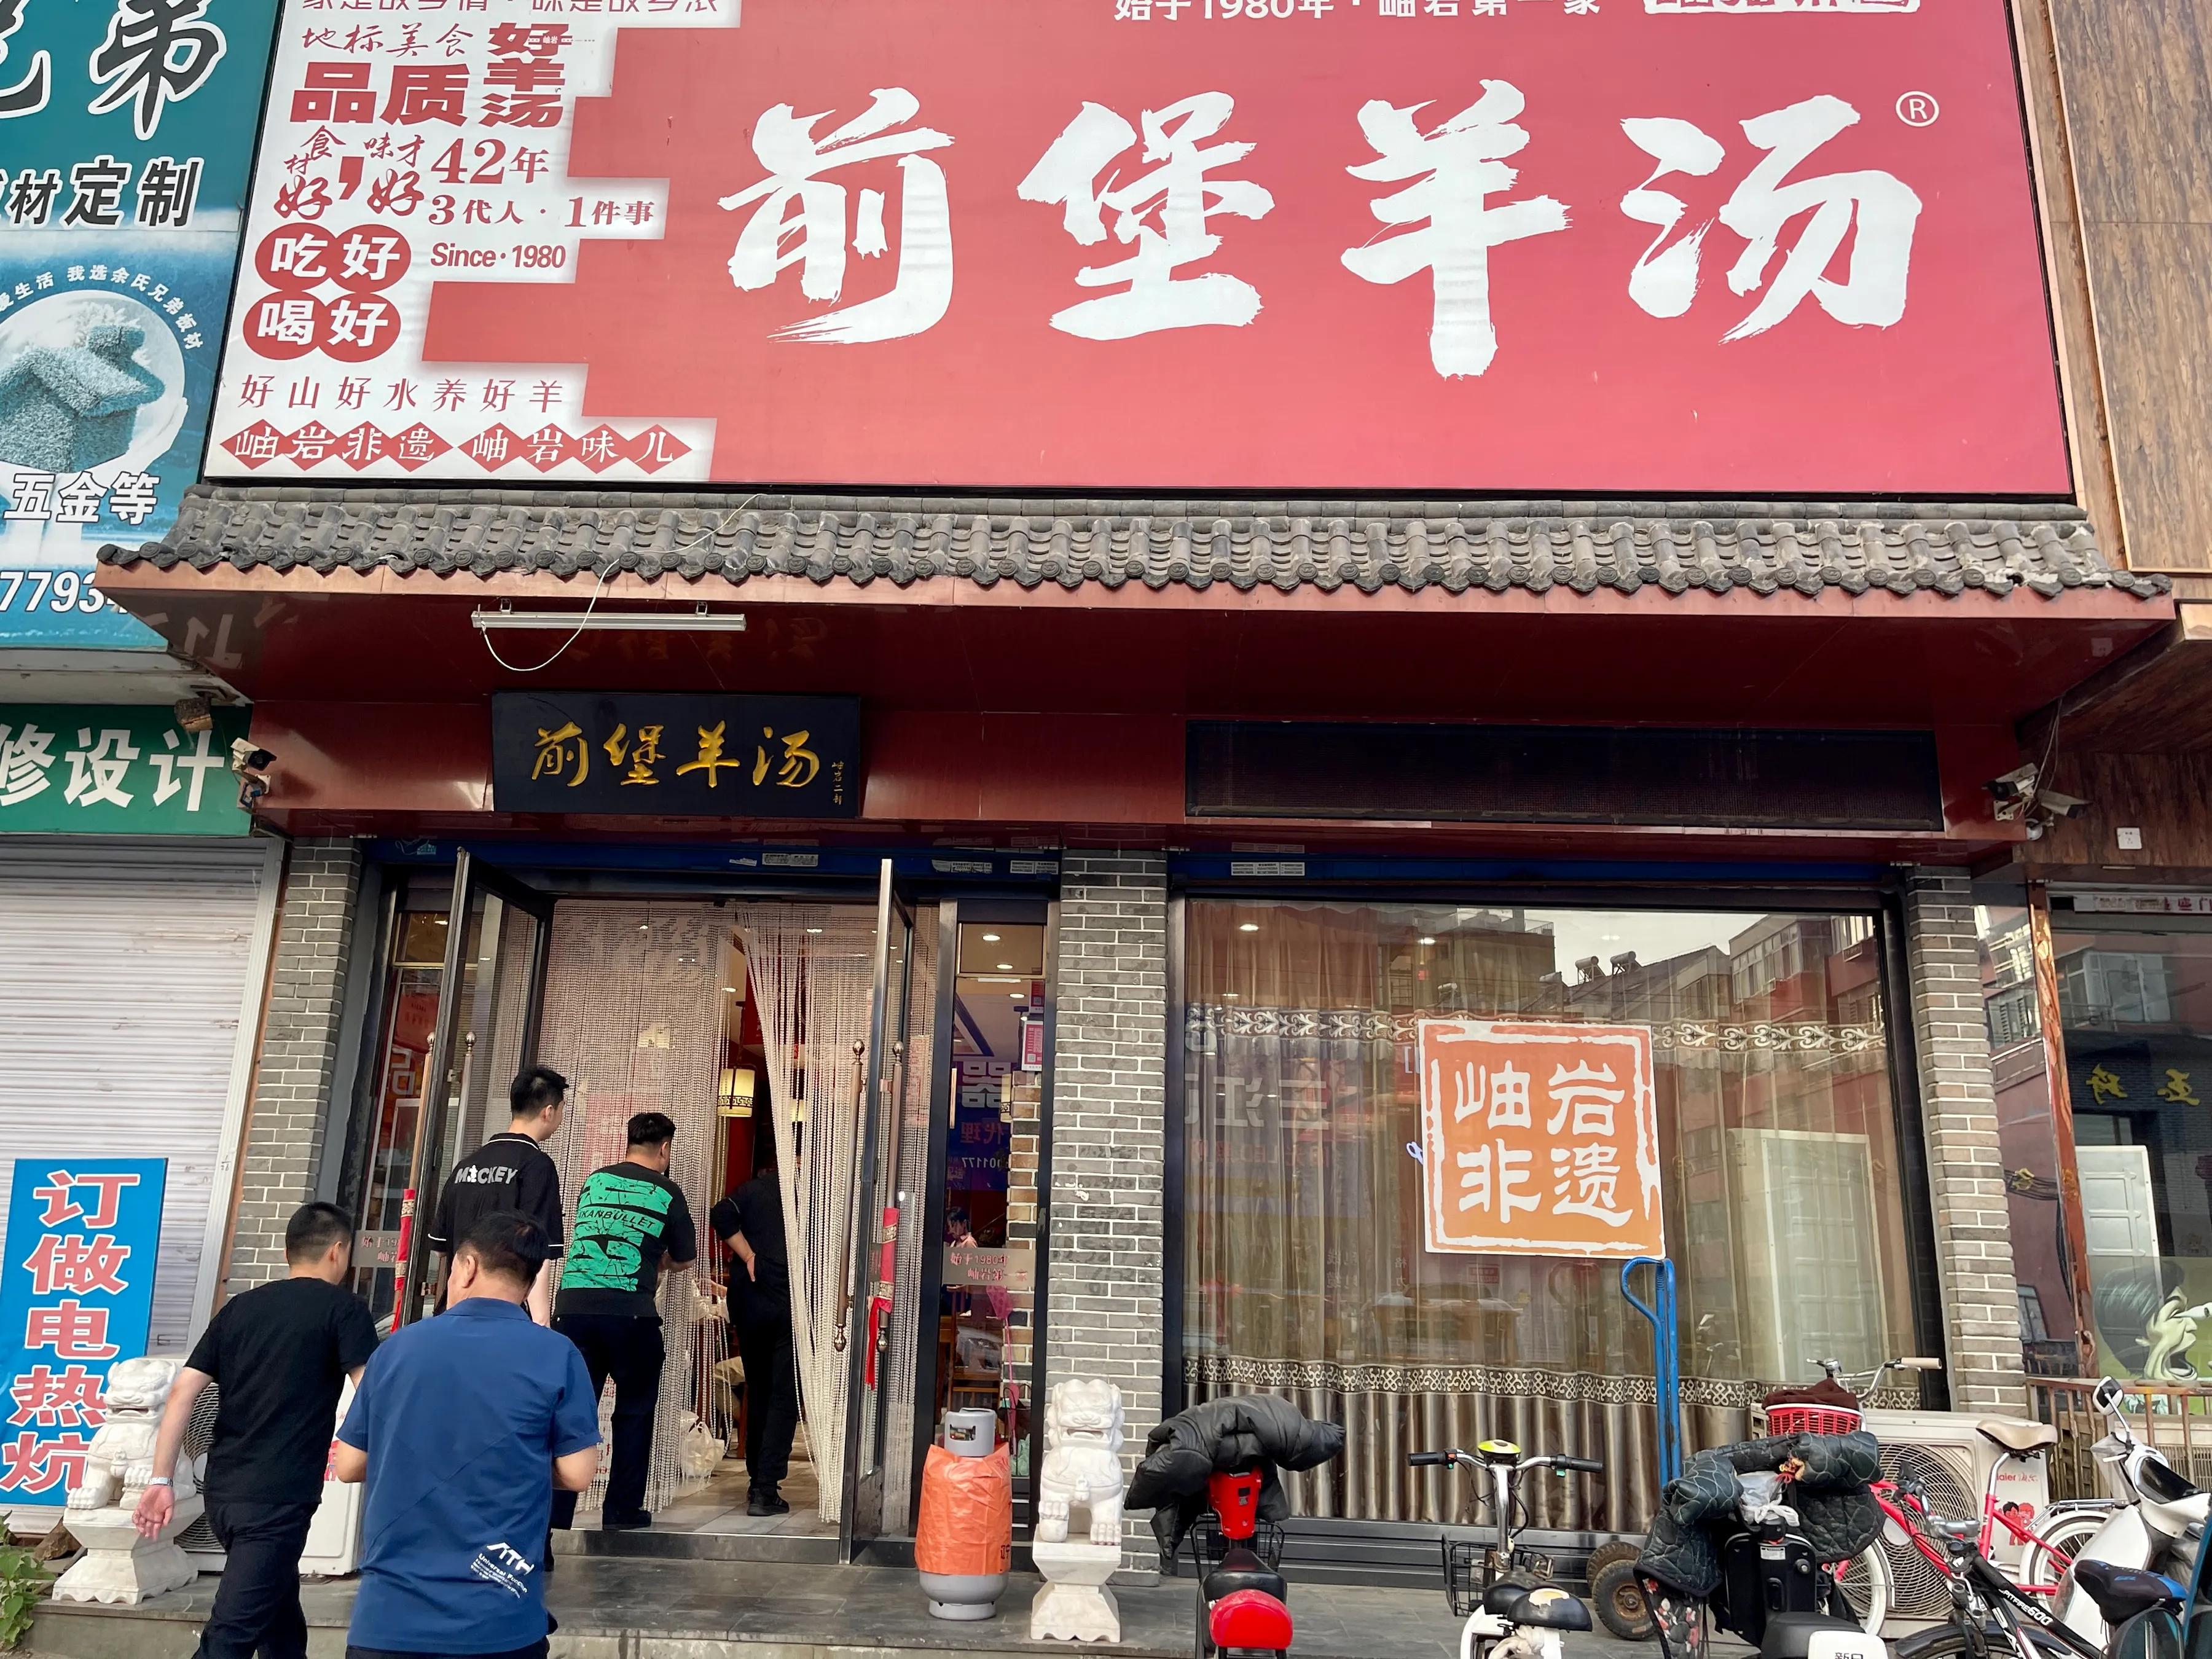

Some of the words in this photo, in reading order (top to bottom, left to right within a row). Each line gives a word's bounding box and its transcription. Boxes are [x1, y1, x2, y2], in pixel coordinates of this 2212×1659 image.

[302, 23, 474, 57] 地标美食
[289, 61, 470, 127] 品质
[0, 155, 204, 231] 材定制
[430, 137, 549, 185] 42年
[716, 79, 1923, 379] 前堡羊汤
[238, 374, 564, 414] 好山好水养好羊
[235, 420, 436, 461] 岫岩非遗
[4, 471, 160, 525] 五金等
[0, 723, 225, 812] 修设计
[531, 720, 820, 788] 前堡羊汤
[0, 1169, 141, 1494] 订做电热炕
